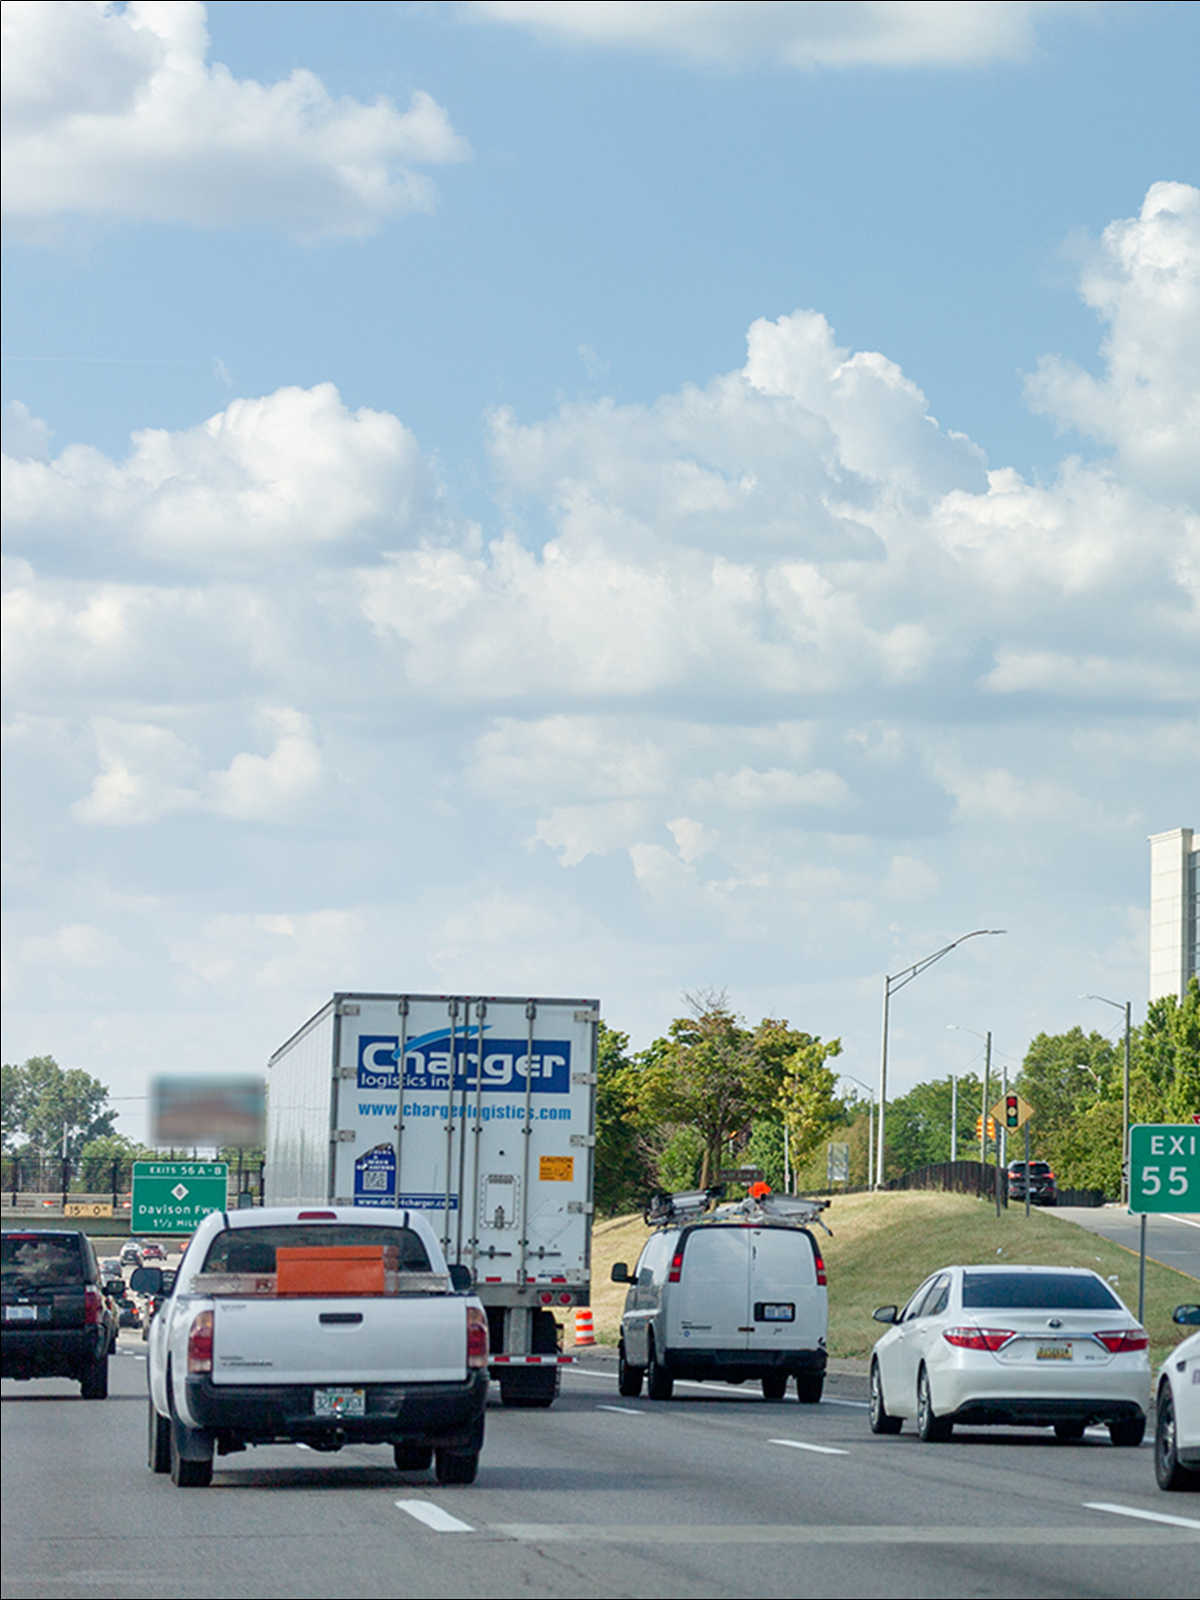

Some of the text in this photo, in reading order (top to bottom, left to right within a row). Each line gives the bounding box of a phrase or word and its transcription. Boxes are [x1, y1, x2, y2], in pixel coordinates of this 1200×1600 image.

[362, 1042, 566, 1085] Charger
[150, 1166, 176, 1175] EXITS
[1142, 1166, 1189, 1196] 55
[139, 1204, 191, 1215] Davison
